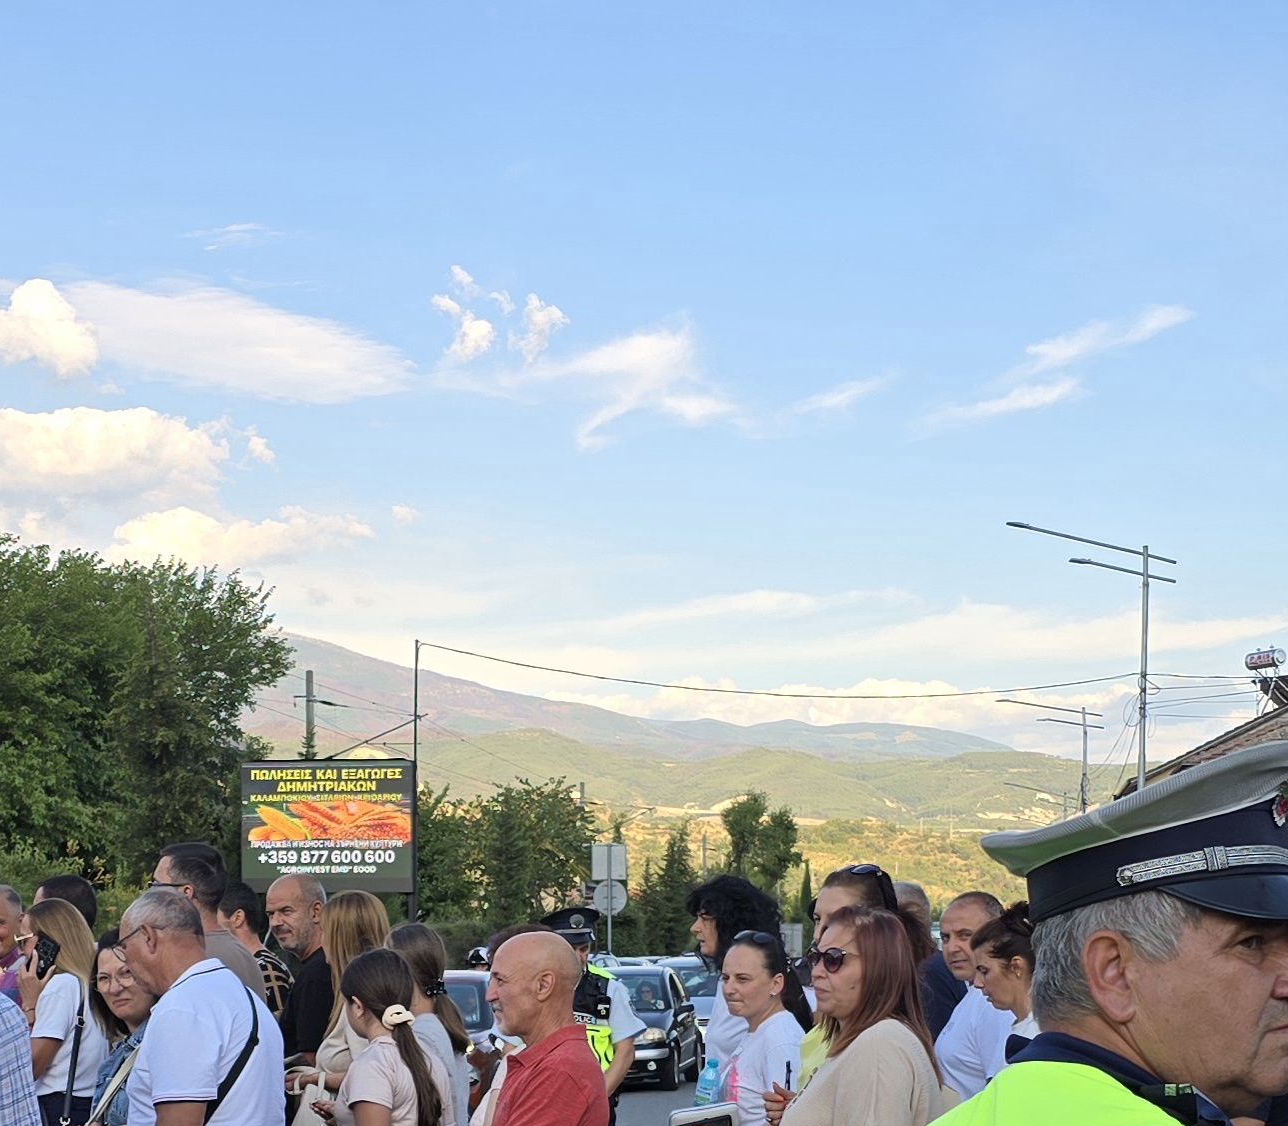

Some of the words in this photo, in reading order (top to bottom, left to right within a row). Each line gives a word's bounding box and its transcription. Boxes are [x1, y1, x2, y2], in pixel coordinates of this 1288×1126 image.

[250, 769, 312, 780] ΠΩΛΗΣΕΙΣ
[316, 769, 337, 780] ΚΑΙ
[341, 768, 403, 779] ΕΞΑΓΩΓΕΣ
[277, 781, 377, 792] ΔΗΜΗΤΡΙΑΚΩΝ
[258, 850, 297, 864] +359
[300, 850, 328, 863] 877
[331, 850, 361, 863] 600
[364, 850, 395, 863] 600
